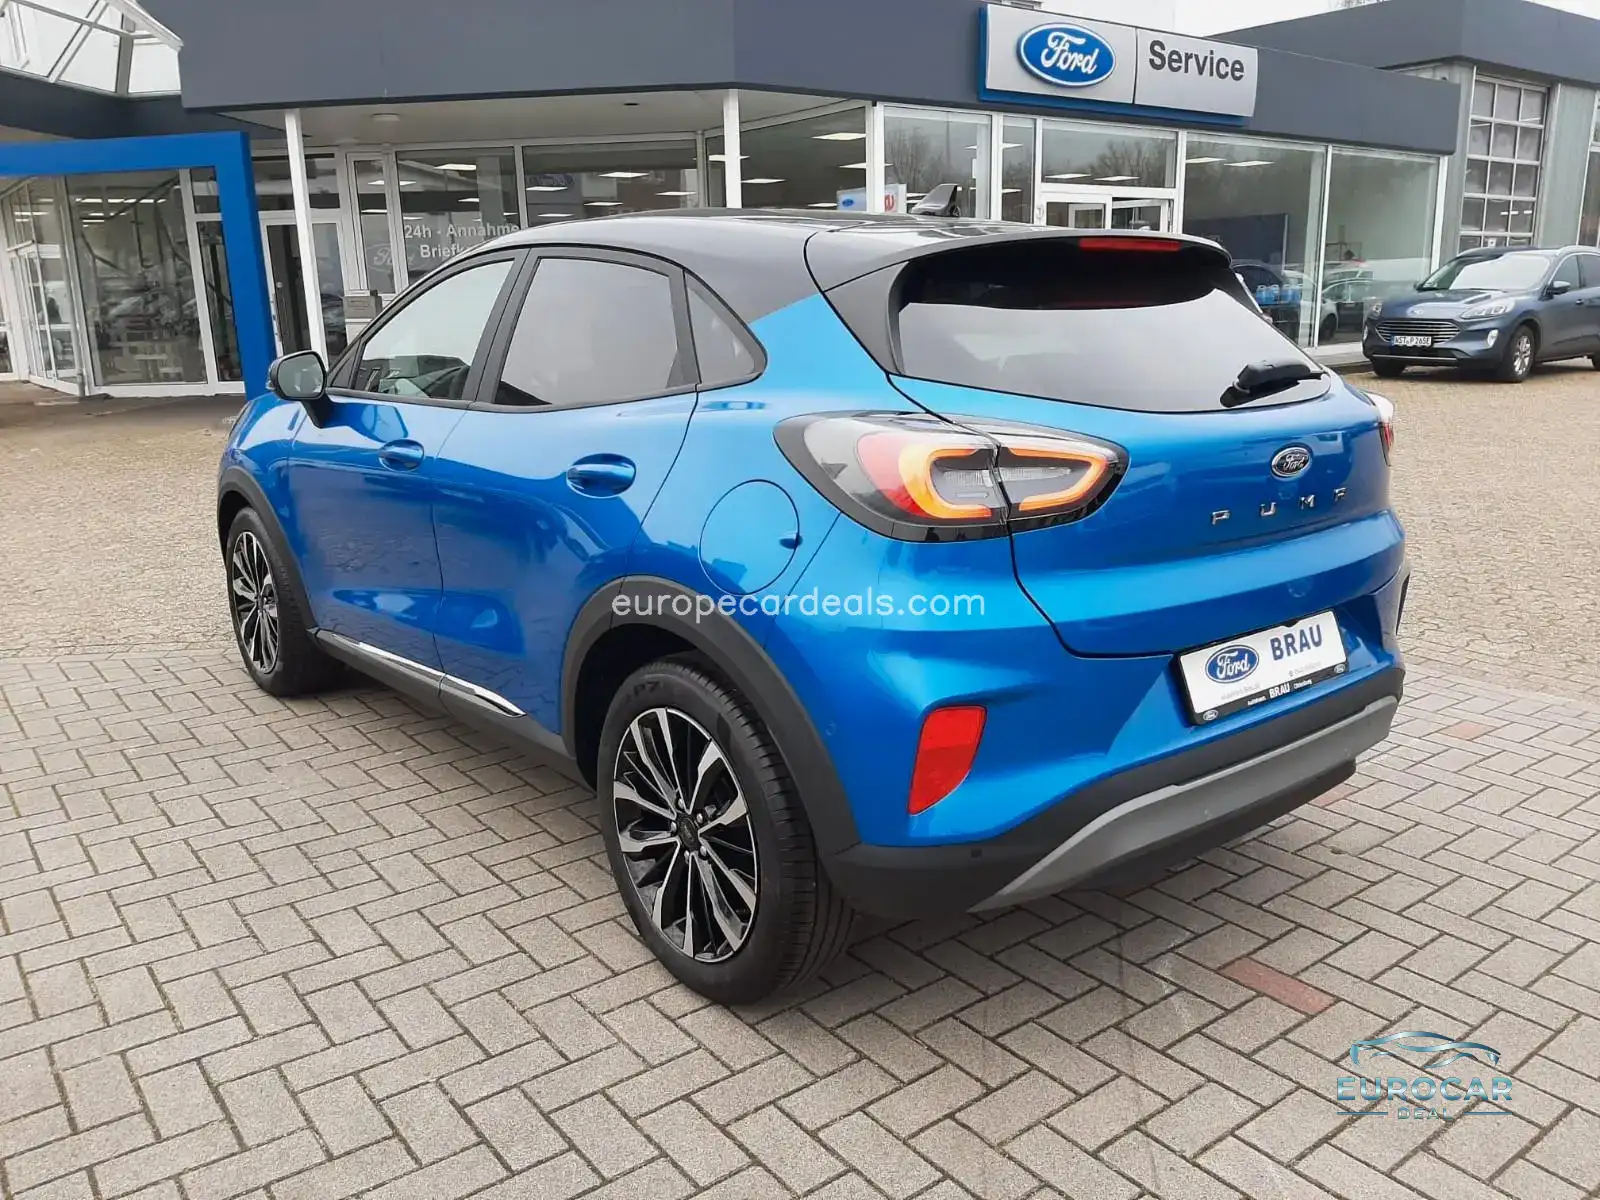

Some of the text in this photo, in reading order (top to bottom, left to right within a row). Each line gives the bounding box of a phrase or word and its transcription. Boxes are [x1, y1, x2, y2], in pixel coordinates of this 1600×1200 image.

[1040, 31, 1099, 75] Ford
[1149, 40, 1245, 81] Service
[404, 224, 432, 239] 24h
[446, 223, 519, 238] Annahme
[1270, 624, 1323, 661] BRAU
[1216, 650, 1250, 679] Ford
[1269, 682, 1291, 699] BRAU
